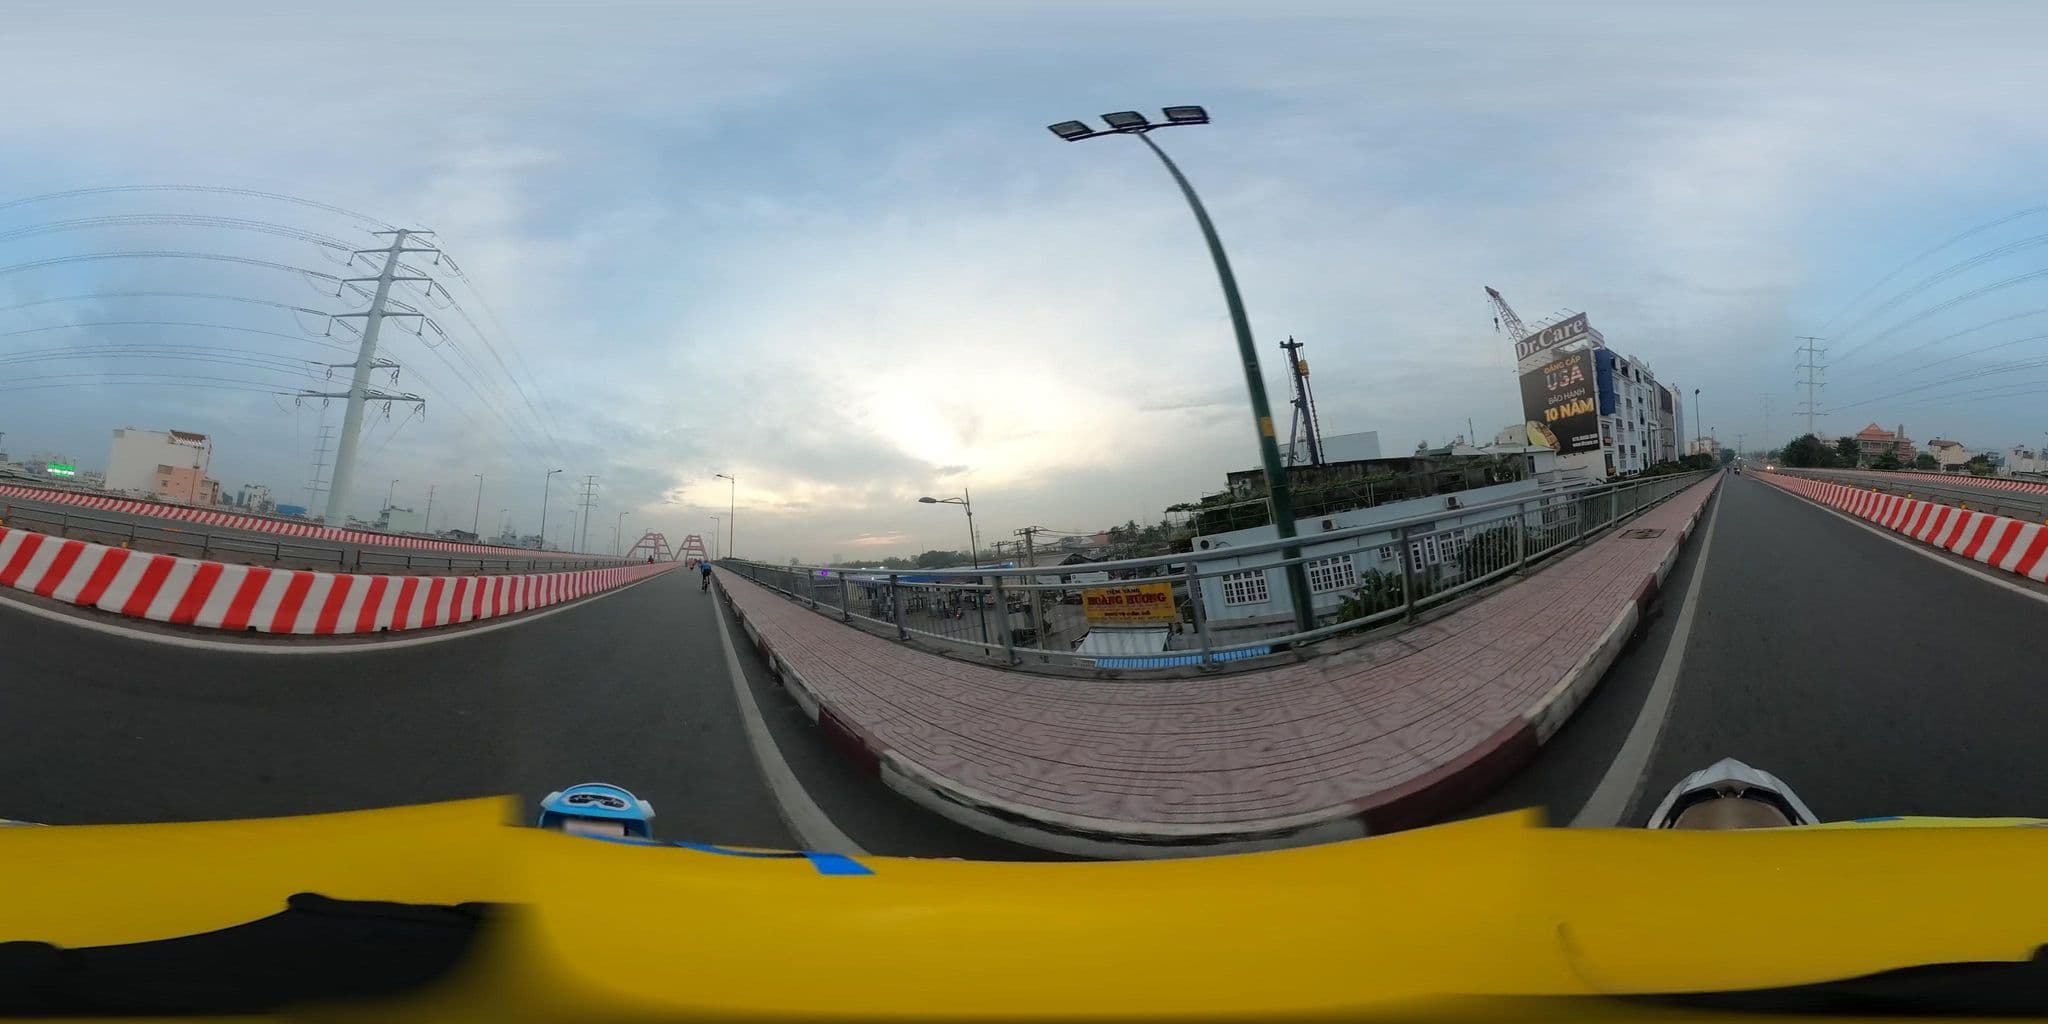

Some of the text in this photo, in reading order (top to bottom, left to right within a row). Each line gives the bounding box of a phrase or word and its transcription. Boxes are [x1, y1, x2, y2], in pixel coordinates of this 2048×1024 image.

[1517, 319, 1584, 359] Dr.Care
[1546, 366, 1584, 390] USA
[1544, 397, 1594, 422] 10 NĂM
[1087, 594, 1123, 605] HOÀNG
